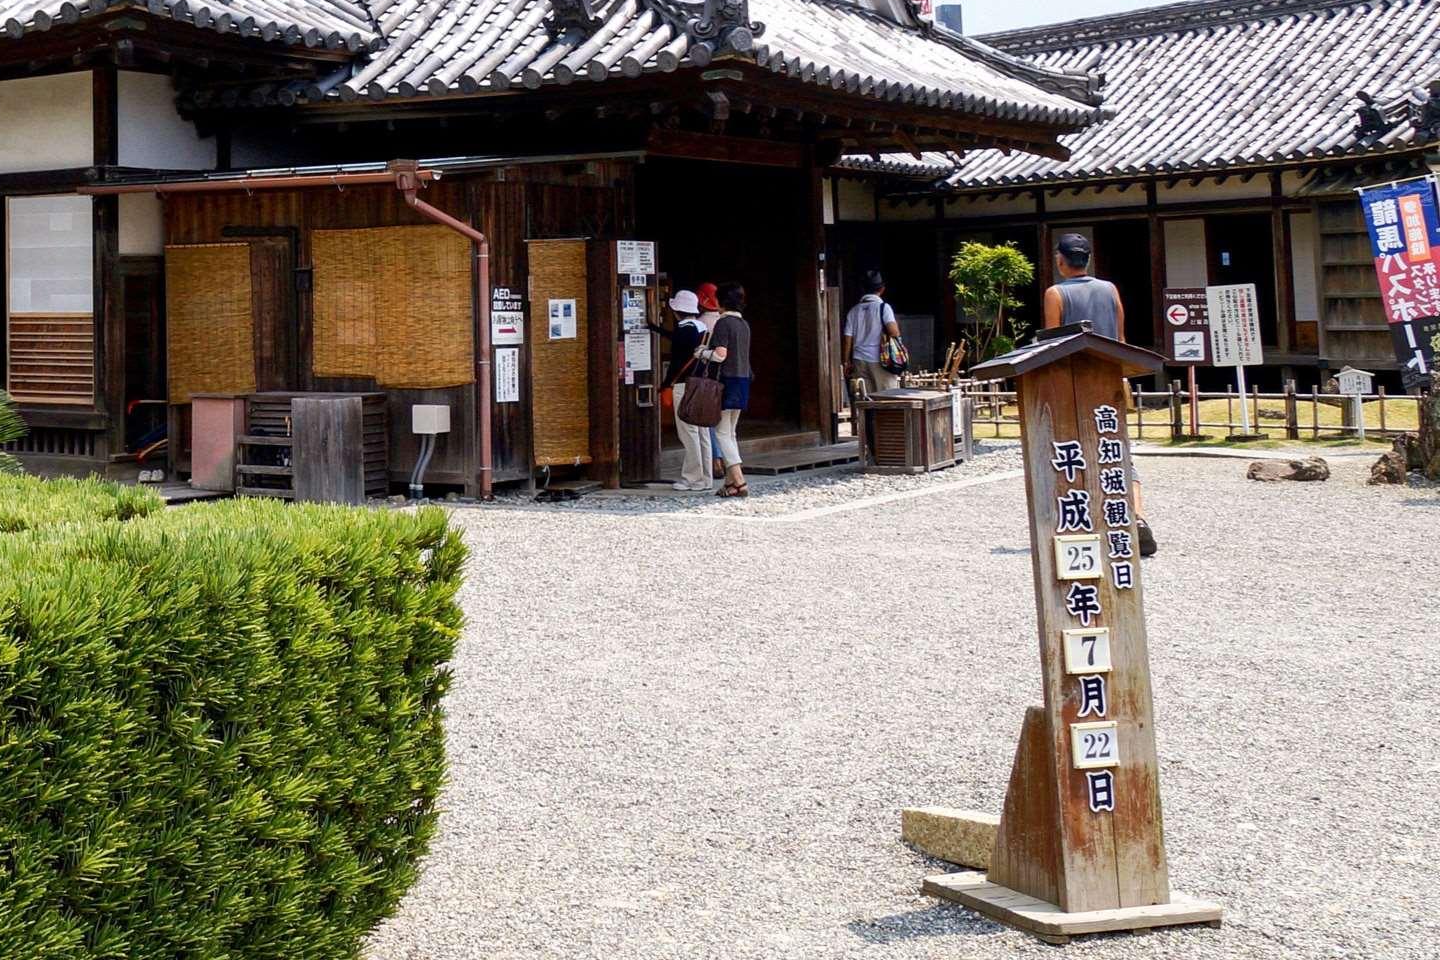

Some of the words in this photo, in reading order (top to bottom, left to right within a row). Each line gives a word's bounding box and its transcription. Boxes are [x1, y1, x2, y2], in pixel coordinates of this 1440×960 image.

[493, 288, 510, 299] AED
[1093, 406, 1133, 590] 高知城観覧日
